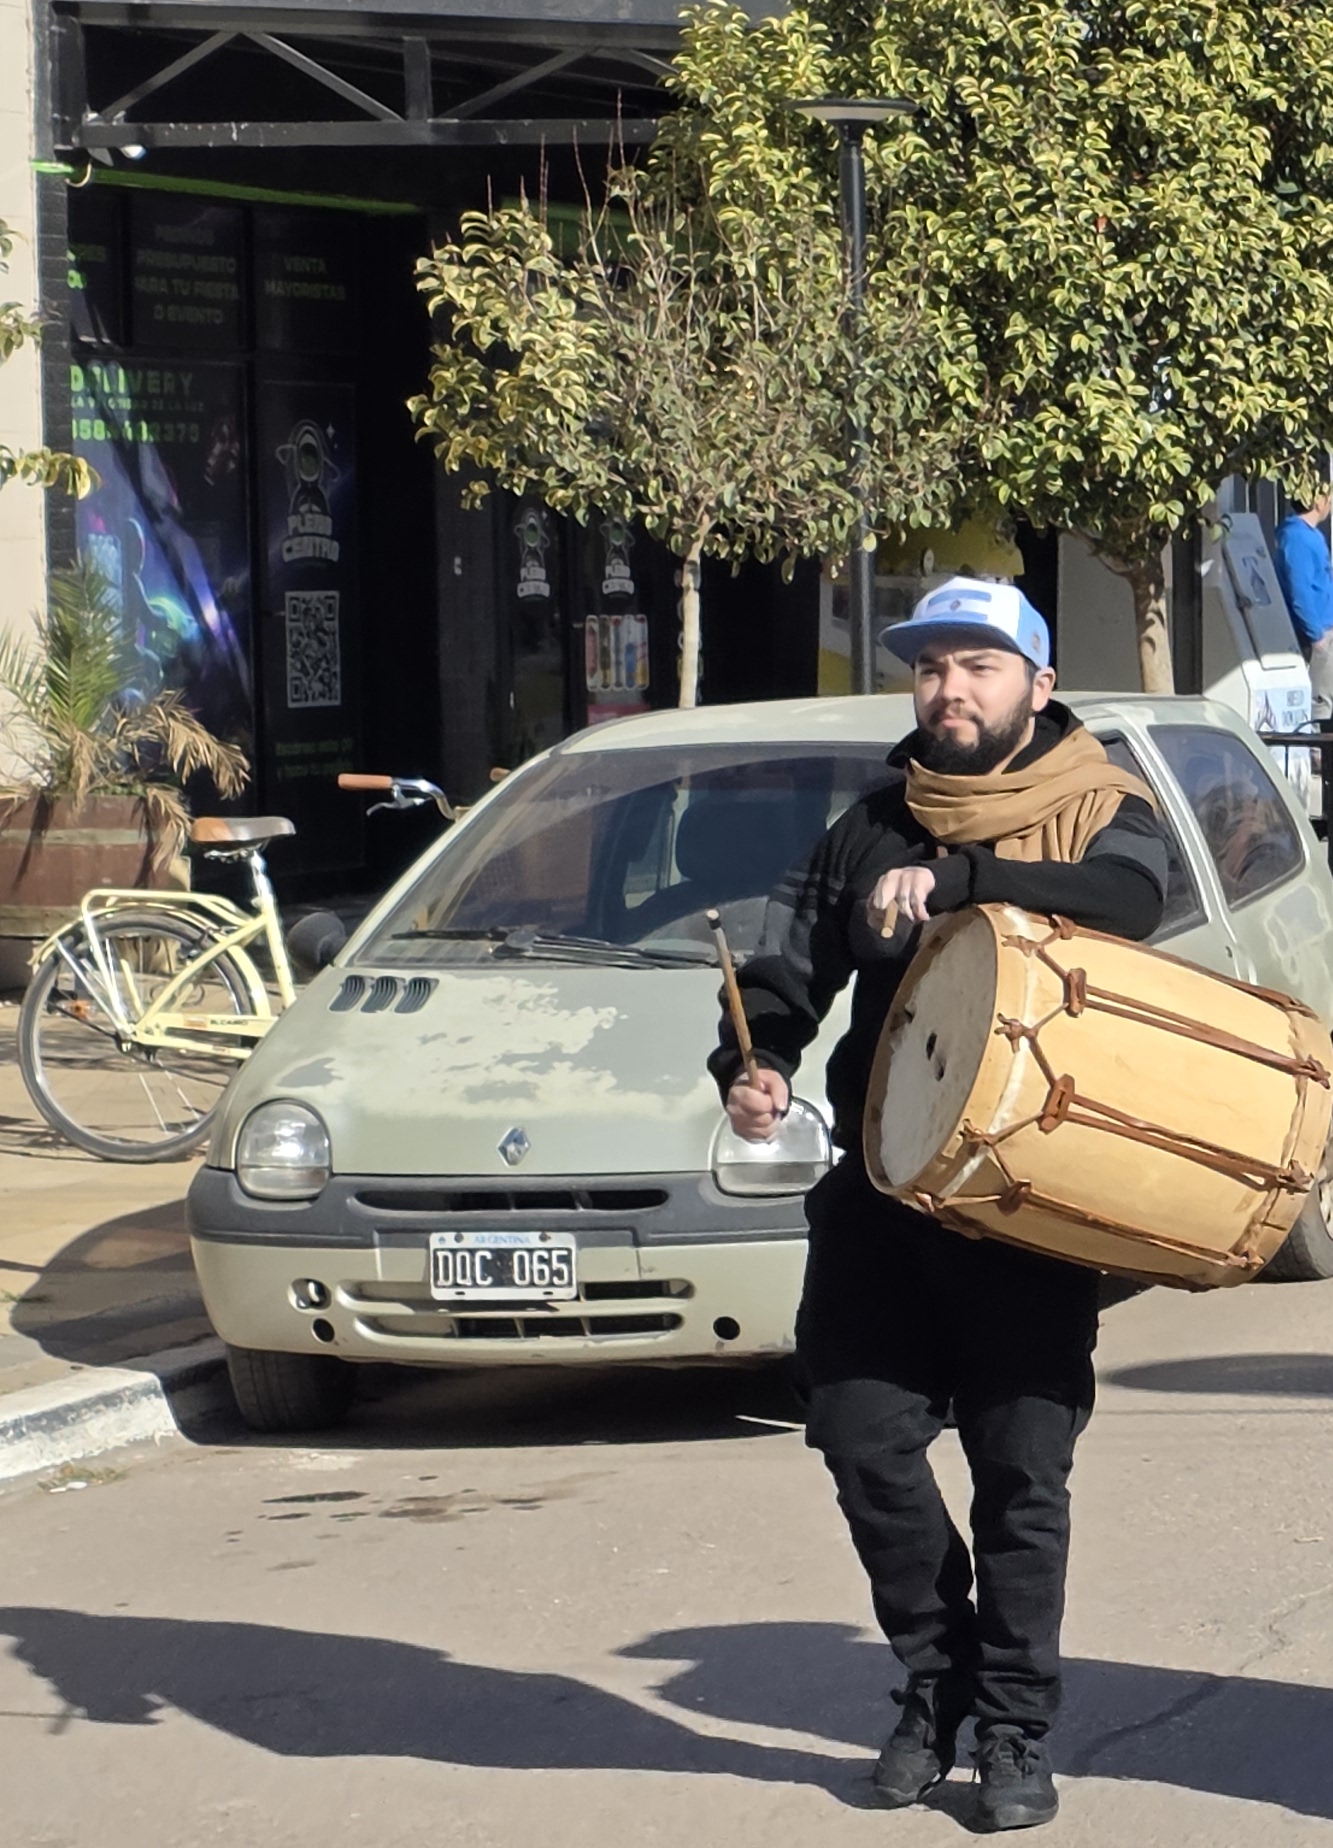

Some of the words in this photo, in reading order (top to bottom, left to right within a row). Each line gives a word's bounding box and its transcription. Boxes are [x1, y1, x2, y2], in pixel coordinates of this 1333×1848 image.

[474, 1235, 531, 1245] ARGENTINA
[436, 1250, 494, 1287] DQC
[513, 1250, 569, 1286] 065
